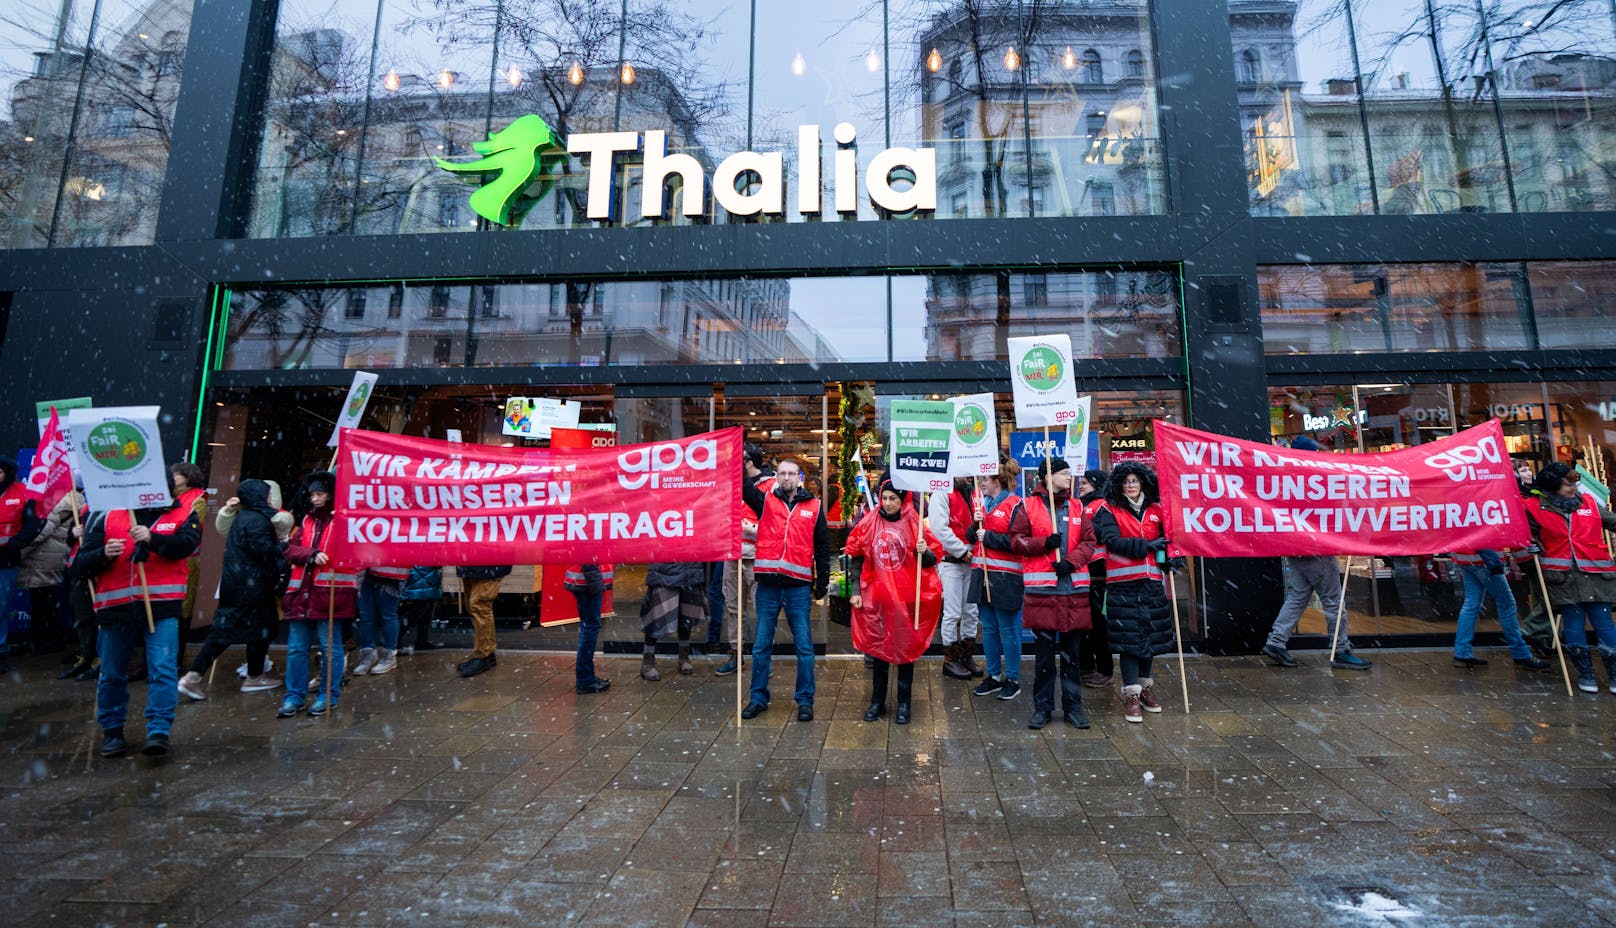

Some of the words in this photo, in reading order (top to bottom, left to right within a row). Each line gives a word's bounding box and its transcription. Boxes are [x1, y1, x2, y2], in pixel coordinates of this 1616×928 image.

[567, 122, 937, 220] Thalia
[1055, 410, 1076, 422] gpa
[899, 439, 946, 448] ARBEITEN
[900, 429, 918, 438] WIR
[351, 450, 411, 477] WIR
[617, 439, 717, 490] gpa
[899, 456, 919, 467] FÜR
[920, 458, 946, 468] ZWEI
[1175, 441, 1244, 468] WIR
[1424, 435, 1502, 482] gpa
[349, 478, 410, 510] FÜR
[415, 480, 571, 510] UNSEREN
[662, 481, 717, 489] GEWERKSCHAFT
[929, 479, 950, 490] gpa
[1180, 468, 1248, 500] FÜR
[1255, 474, 1410, 500] UNSEREN
[138, 492, 165, 505] gpa
[347, 509, 694, 544] KOLLEKTIVVERTRAG!
[1182, 499, 1511, 534] KOLLEKTIVVERTRAG!
